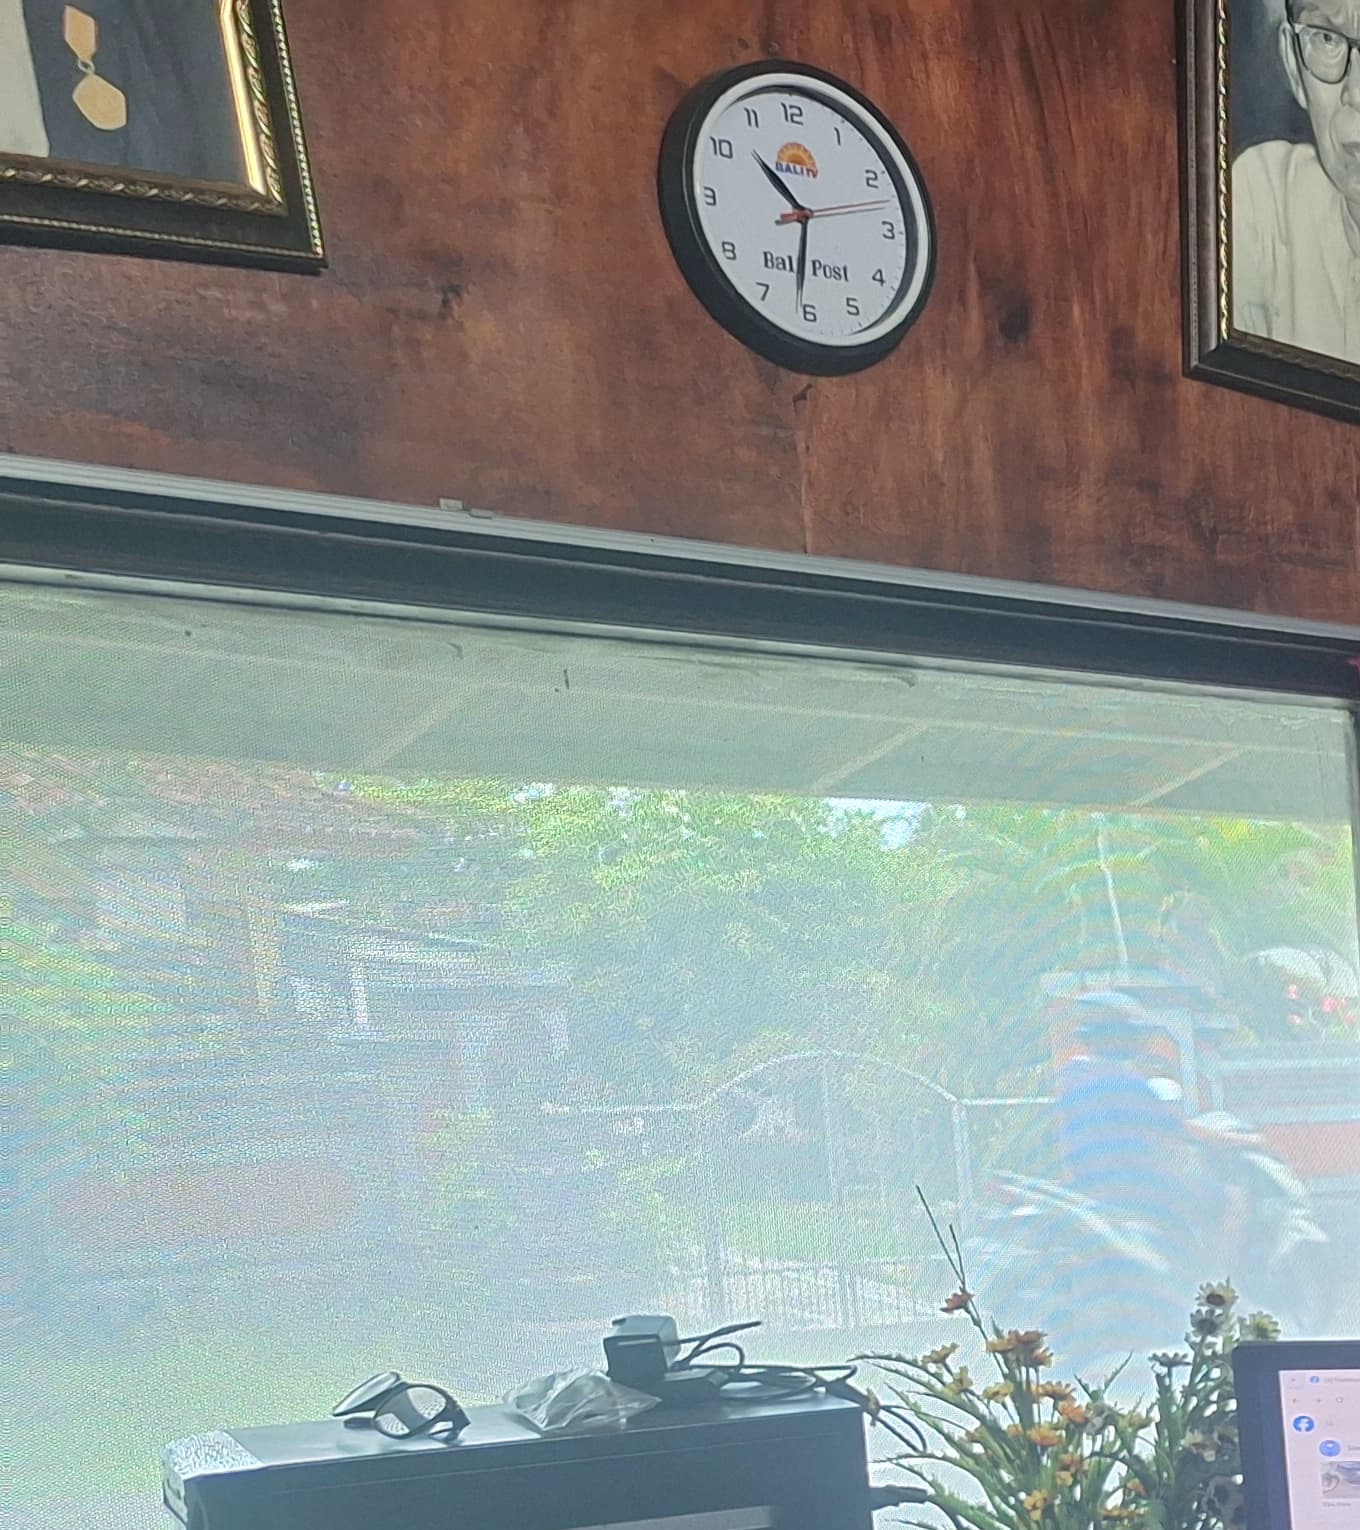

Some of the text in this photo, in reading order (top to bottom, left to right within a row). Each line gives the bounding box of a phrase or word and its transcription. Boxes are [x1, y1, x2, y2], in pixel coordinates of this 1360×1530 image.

[744, 108, 759, 127] 11
[781, 102, 803, 124] 12
[834, 127, 842, 146] 1
[710, 137, 733, 158] 10
[775, 161, 818, 179] BALI TV
[865, 169, 879, 187] 2
[704, 187, 717, 205] 9
[881, 221, 895, 239] 3
[722, 241, 736, 260] 8
[763, 251, 849, 281] Bal Post
[872, 269, 885, 285] 4
[756, 282, 770, 301] 7
[802, 303, 817, 322] 6
[846, 297, 860, 316] 5
